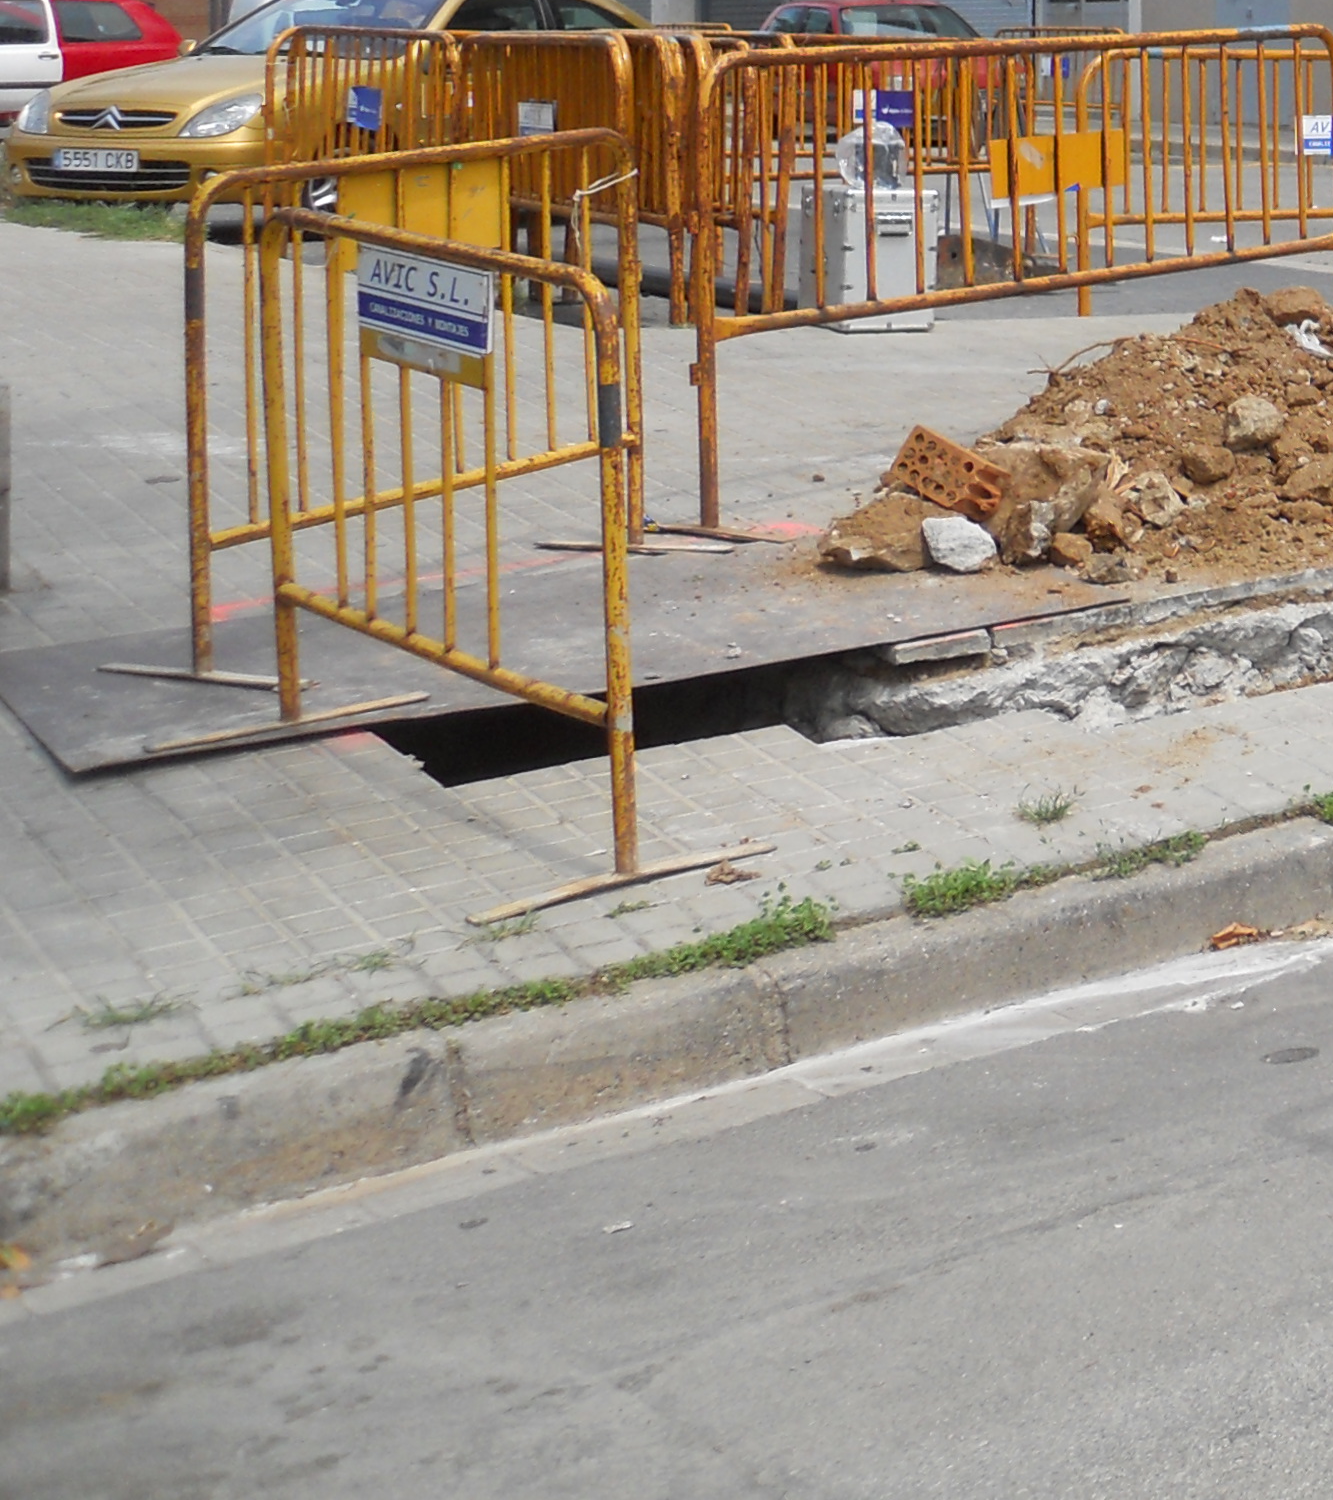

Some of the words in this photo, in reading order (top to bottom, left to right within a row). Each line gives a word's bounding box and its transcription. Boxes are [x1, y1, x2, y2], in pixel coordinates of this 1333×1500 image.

[1310, 120, 1332, 134] AV
[62, 150, 98, 168] 5551
[105, 151, 135, 169] CKB
[370, 258, 418, 292] AVIC
[426, 270, 470, 306] S.L.
